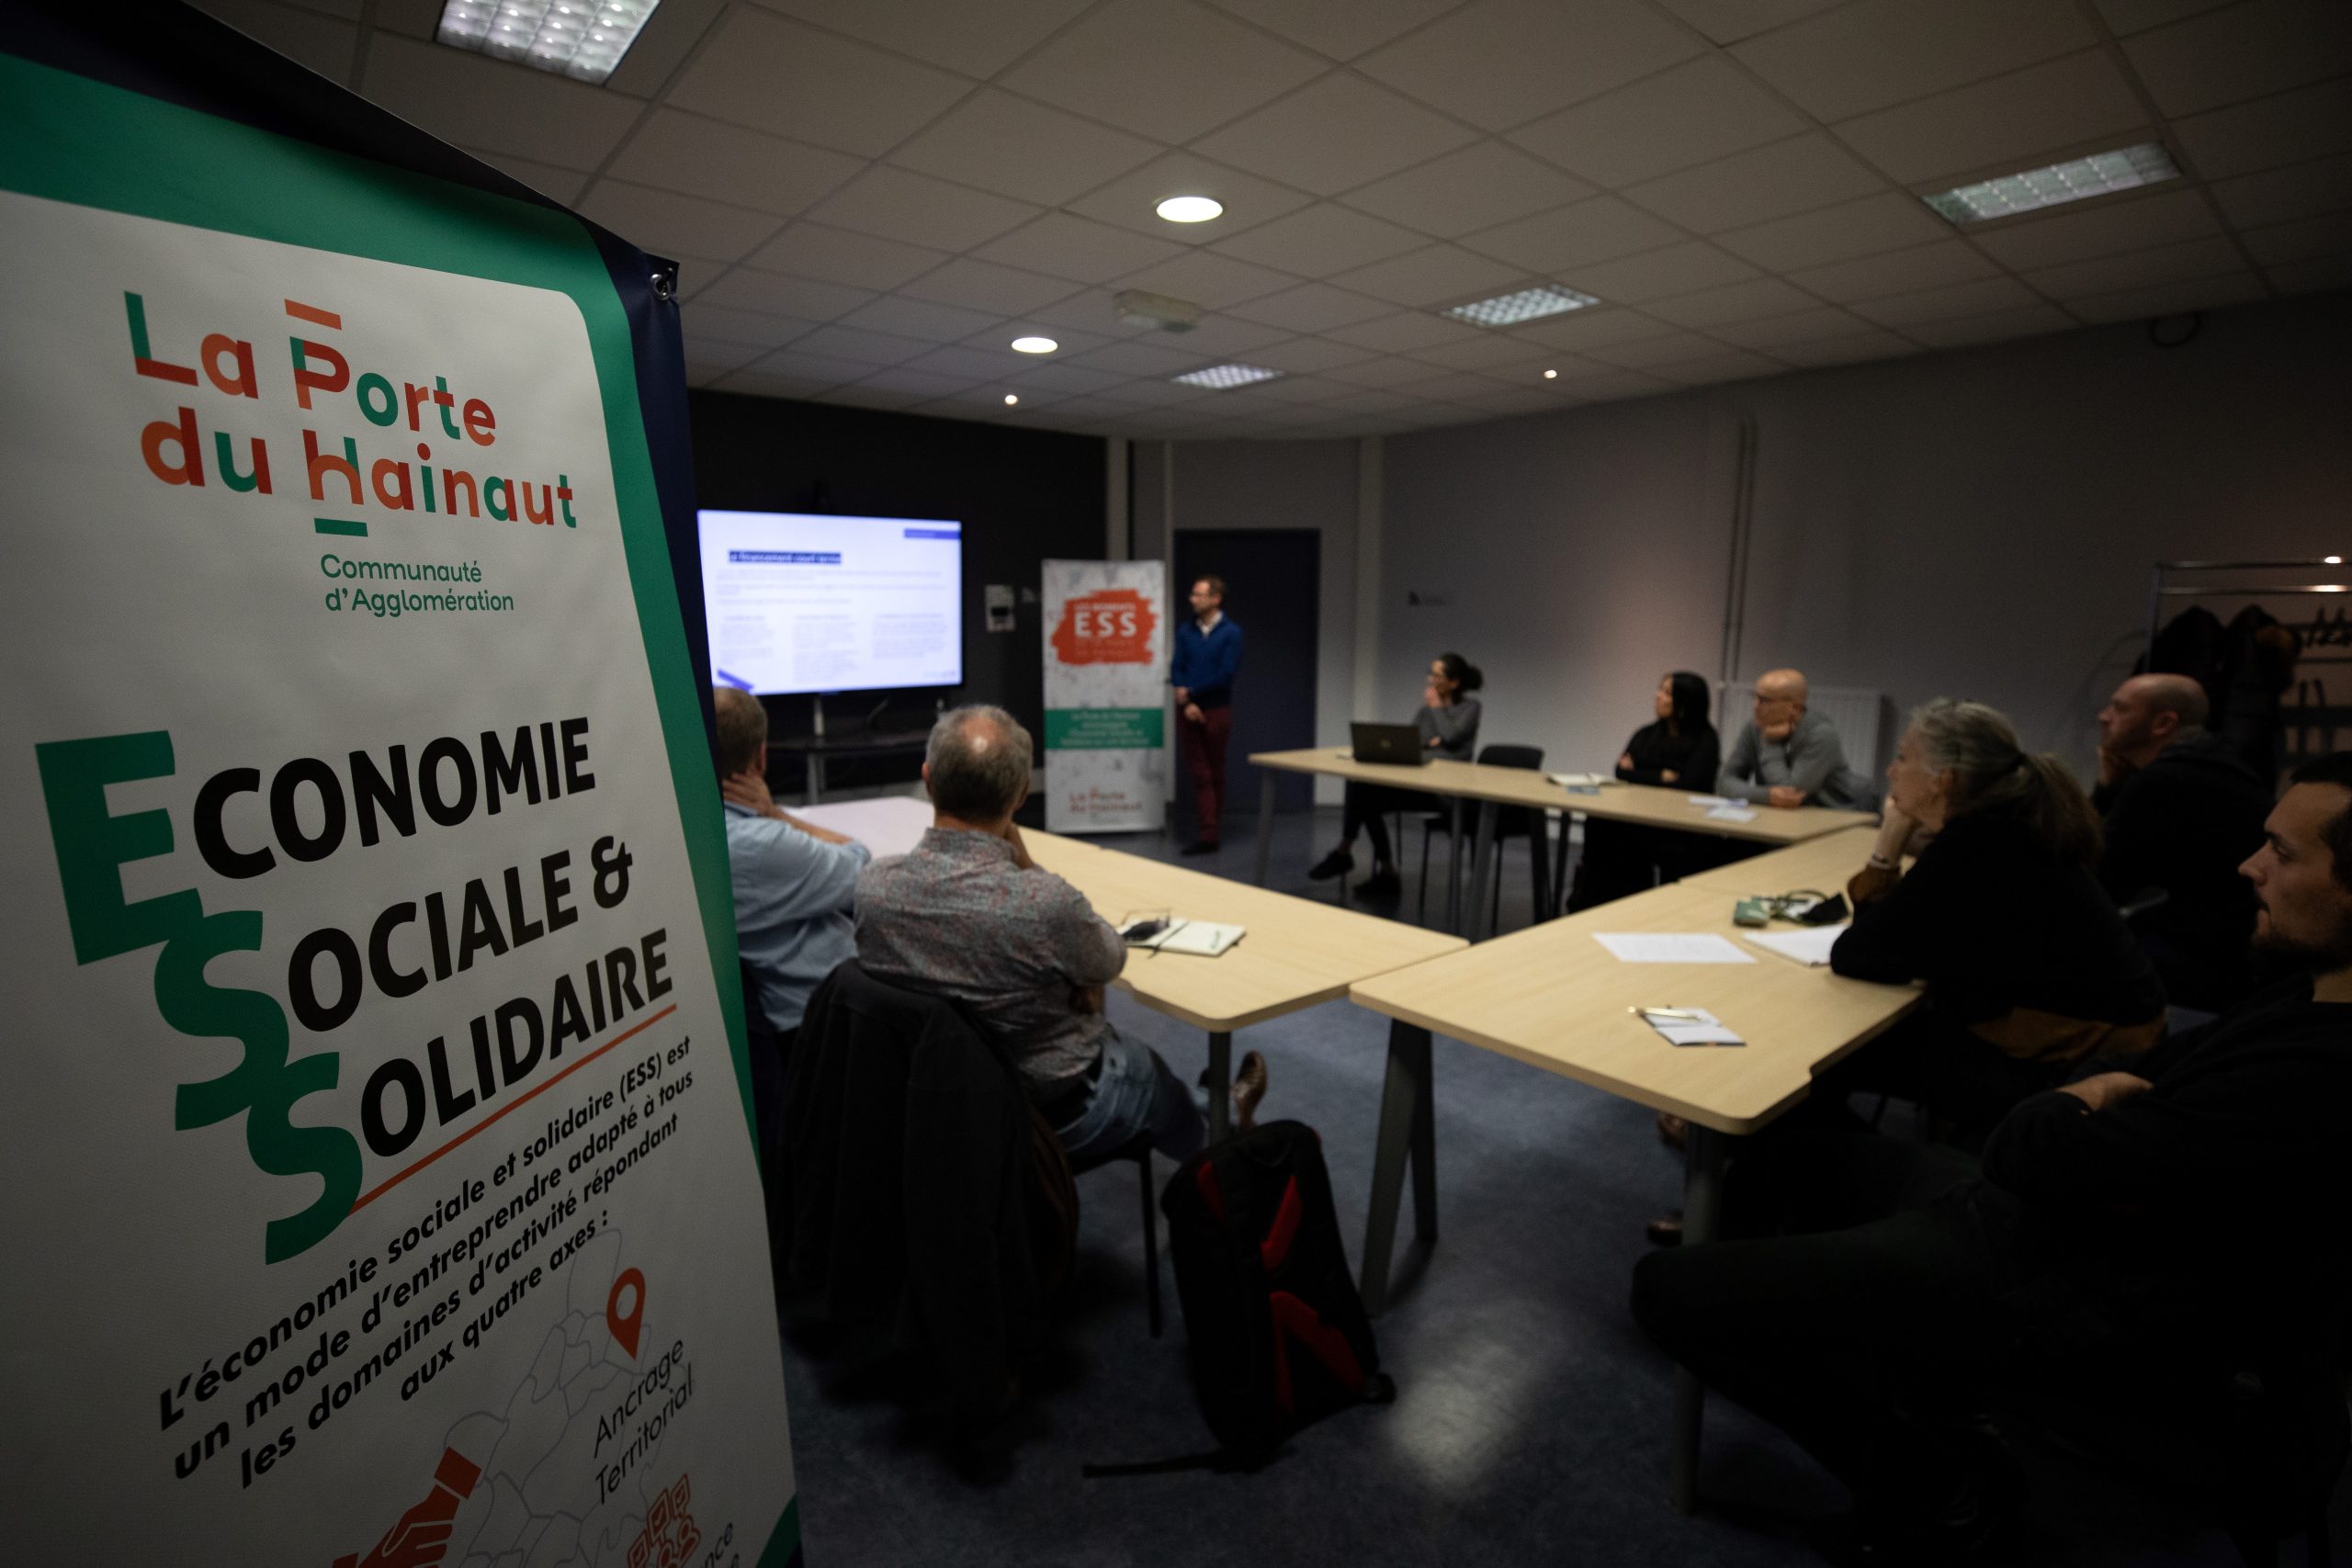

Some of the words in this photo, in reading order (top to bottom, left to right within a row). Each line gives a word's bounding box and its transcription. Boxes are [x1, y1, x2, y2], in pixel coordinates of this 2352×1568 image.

[124, 290, 259, 400] La
[288, 335, 497, 447] Porte
[141, 406, 273, 495] du
[320, 553, 483, 583] Communauté
[324, 587, 515, 618] d'Agglomération
[1074, 612, 1136, 637] ESS
[35, 716, 596, 966] ECONOMIE
[153, 849, 580, 1132] SOCIALE
[590, 835, 634, 909] &
[245, 928, 673, 1267] SOLIDAIRE
[159, 1257, 379, 1431] L'économie
[388, 1179, 486, 1265] sociale
[492, 1152, 516, 1187] et
[523, 1090, 614, 1168] solidaire
[619, 1052, 662, 1104] (ESS)
[666, 1035, 690, 1066] est
[175, 1421, 231, 1480] un
[245, 1329, 351, 1428] mode
[361, 1168, 562, 1335] d'entreprendre
[568, 1104, 639, 1174] adapté
[643, 1093, 655, 1119] à
[659, 1071, 693, 1107] tous
[241, 1426, 297, 1490] les
[308, 1289, 461, 1431] domaines
[469, 1188, 577, 1296] d'activité
[583, 1112, 678, 1203] répondant
[401, 1339, 456, 1402] aux
[462, 1266, 543, 1349] quatre
[549, 1219, 596, 1271] axes
[594, 1339, 684, 1460] Ancrage
[594, 1362, 693, 1506] Territorial
